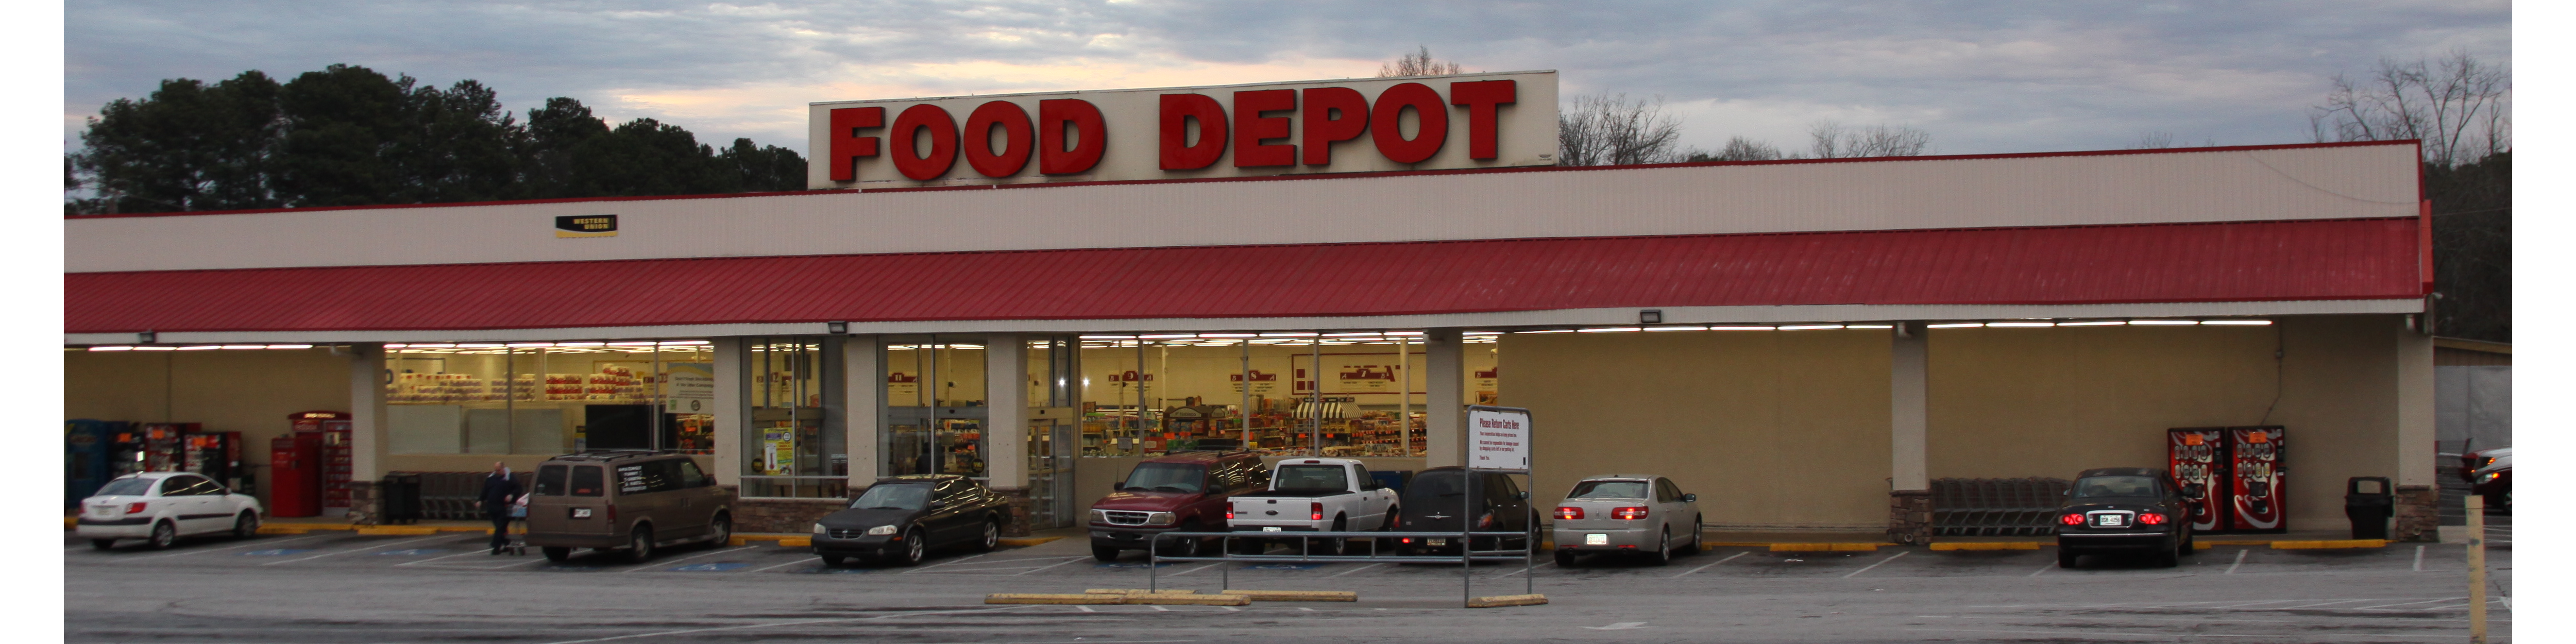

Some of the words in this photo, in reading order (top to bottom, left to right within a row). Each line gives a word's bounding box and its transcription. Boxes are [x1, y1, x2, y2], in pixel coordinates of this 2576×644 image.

[830, 98, 1107, 181] FOOD
[1159, 79, 1517, 171] DEPOT
[1480, 418, 1491, 428] Please
[1492, 418, 1502, 428] Return
[1503, 419, 1512, 429] Carts
